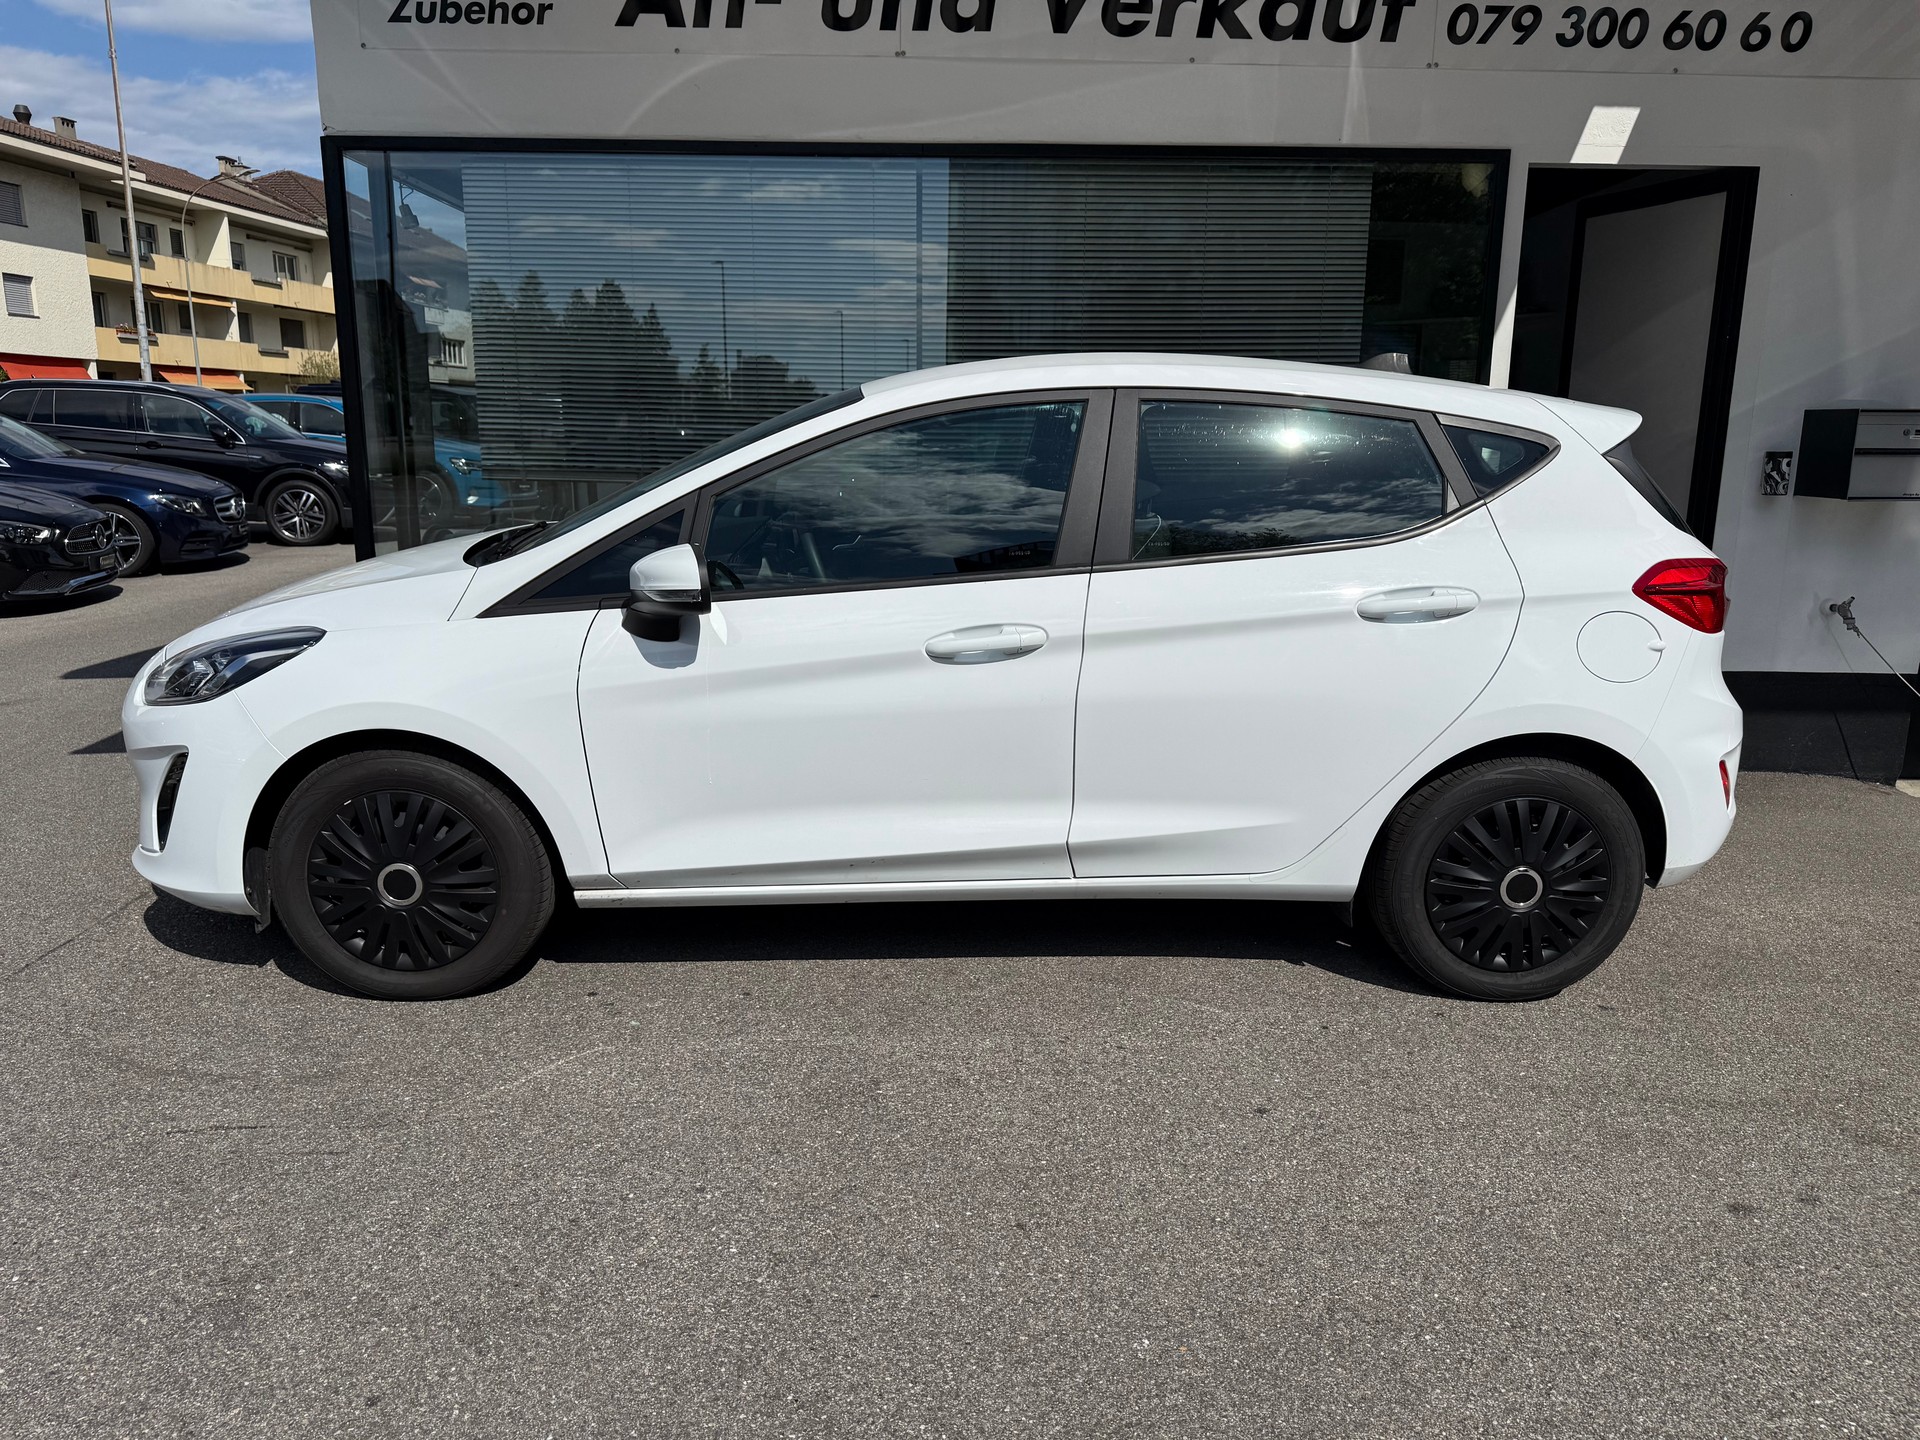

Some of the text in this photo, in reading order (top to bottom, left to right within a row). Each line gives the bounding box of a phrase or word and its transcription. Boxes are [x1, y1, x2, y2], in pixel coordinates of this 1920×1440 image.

[1447, 3, 1543, 46] 079
[1556, 6, 1650, 49] 300
[1663, 10, 1728, 52] 60
